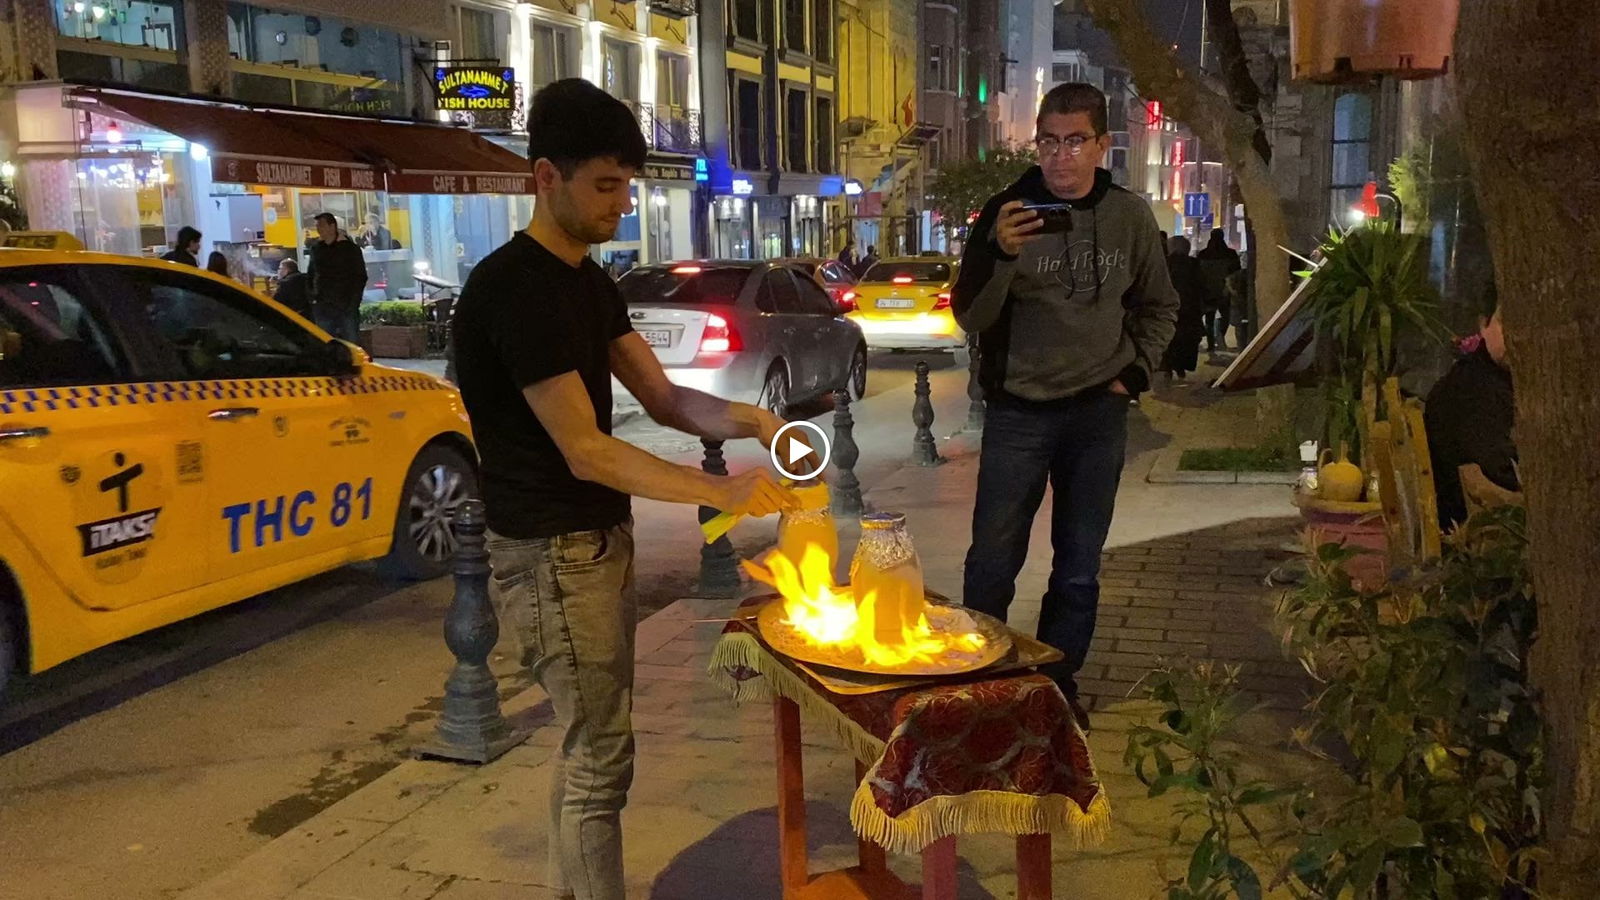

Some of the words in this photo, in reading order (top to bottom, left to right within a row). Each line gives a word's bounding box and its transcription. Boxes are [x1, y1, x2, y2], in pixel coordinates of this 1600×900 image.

[438, 69, 509, 95] SULTANAHMET
[468, 97, 511, 109] HOUSE
[256, 161, 312, 185] SULTANAHMET
[433, 175, 457, 193] CAFE
[463, 176, 470, 193] &
[476, 176, 527, 193] RESTAURANT
[221, 489, 317, 553] THC
[330, 476, 373, 527] 81
